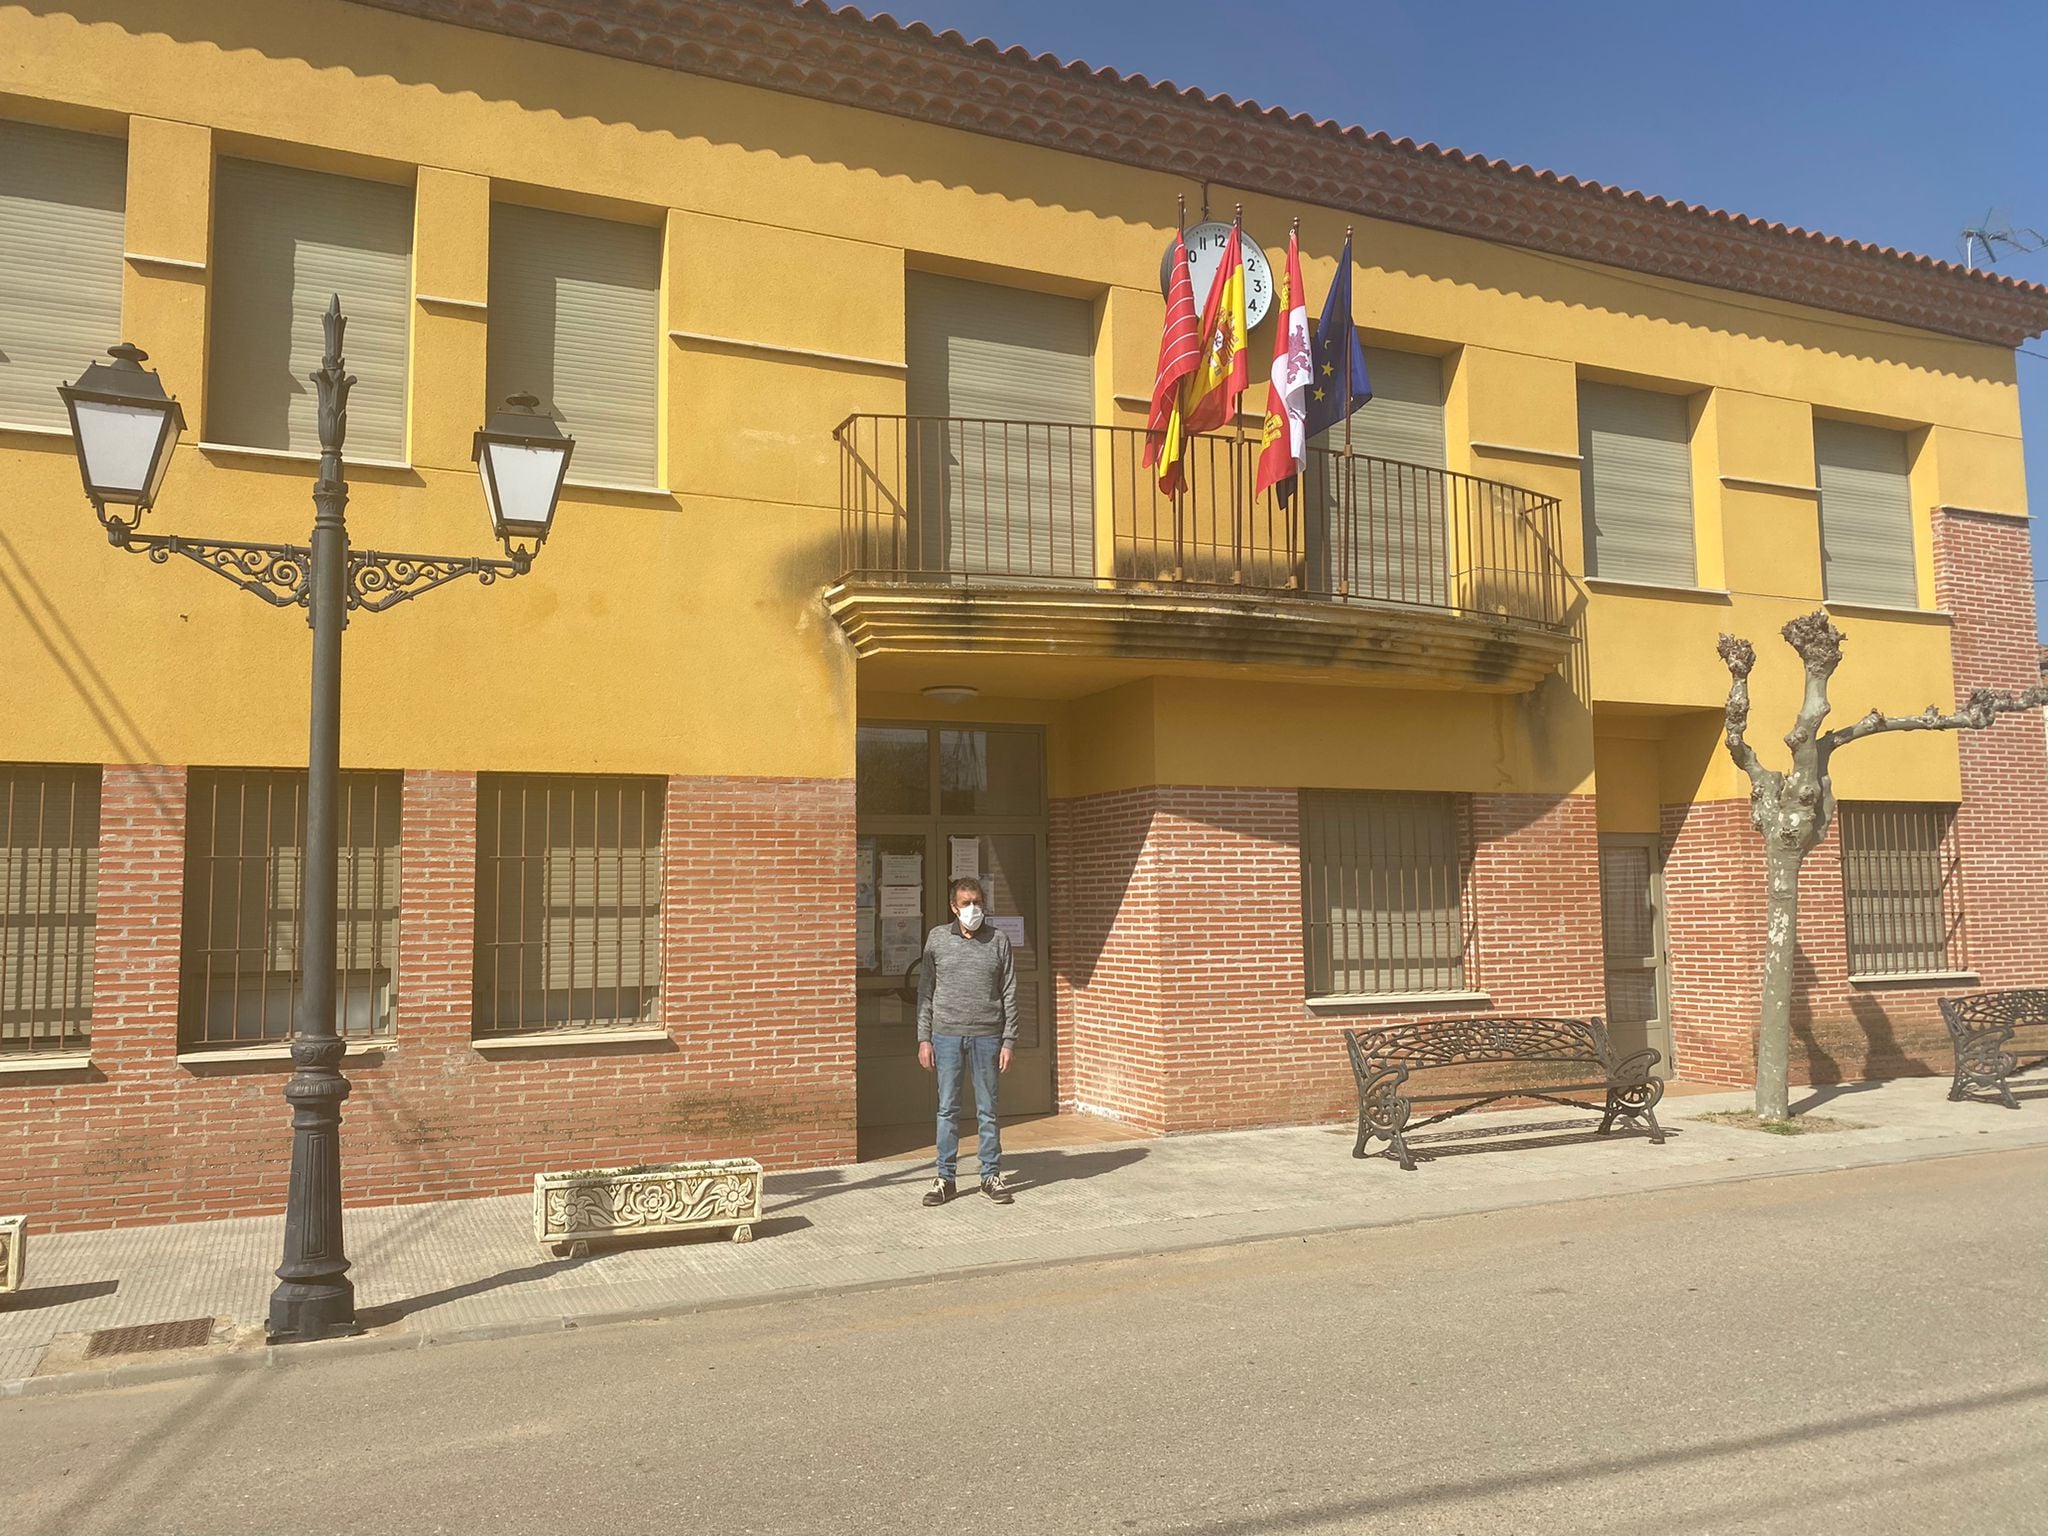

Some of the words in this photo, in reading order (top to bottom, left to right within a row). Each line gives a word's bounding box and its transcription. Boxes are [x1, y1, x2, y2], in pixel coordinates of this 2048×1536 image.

[1200, 238, 1206, 251] 11
[1215, 234, 1225, 248] 12
[1247, 258, 1256, 272] 2
[1253, 280, 1262, 293] 3
[1248, 299, 1257, 312] 4
